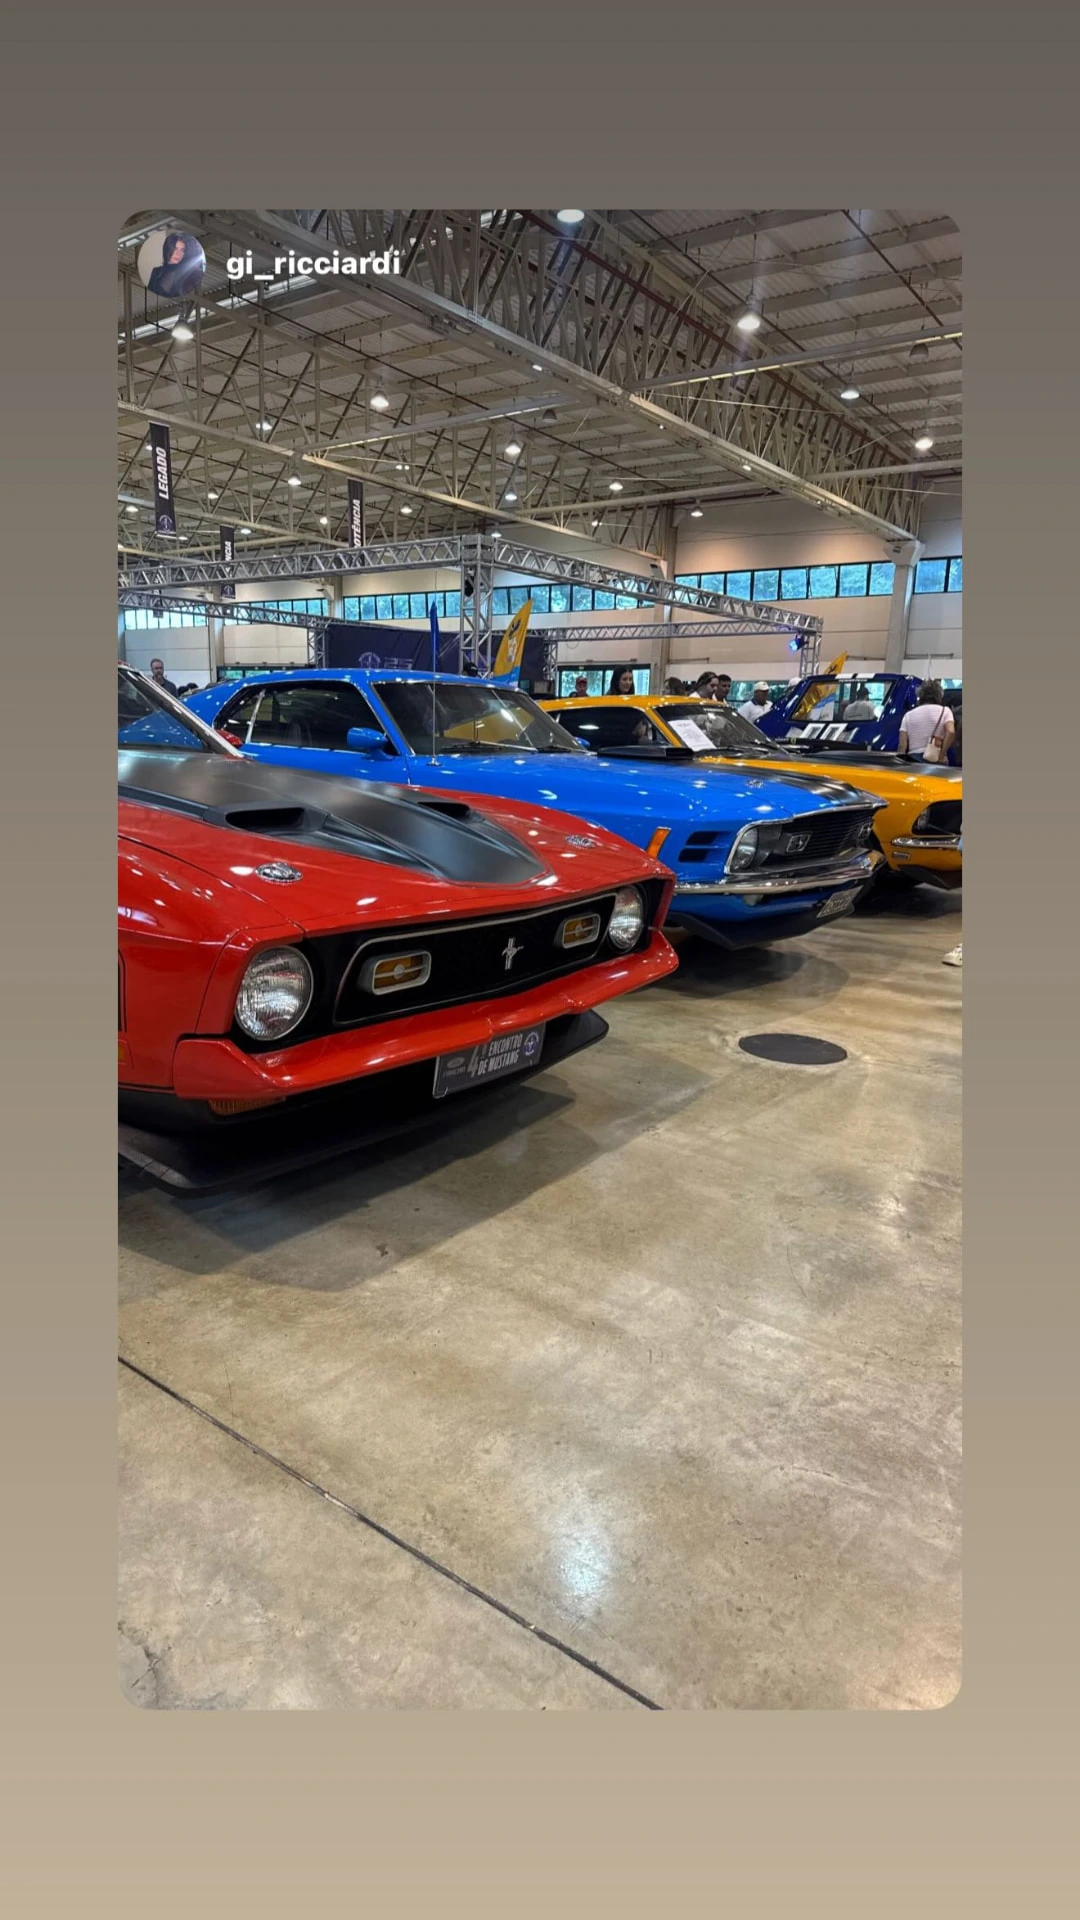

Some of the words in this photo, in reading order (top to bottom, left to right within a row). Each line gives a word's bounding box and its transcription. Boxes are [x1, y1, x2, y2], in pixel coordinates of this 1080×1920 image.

[155, 446, 170, 500] LEGADO
[352, 499, 362, 549] OTÊNCIA
[477, 1059, 489, 1076] DE
[487, 1049, 520, 1072] MUSTANG
[488, 1033, 524, 1057] ENCONTRO
